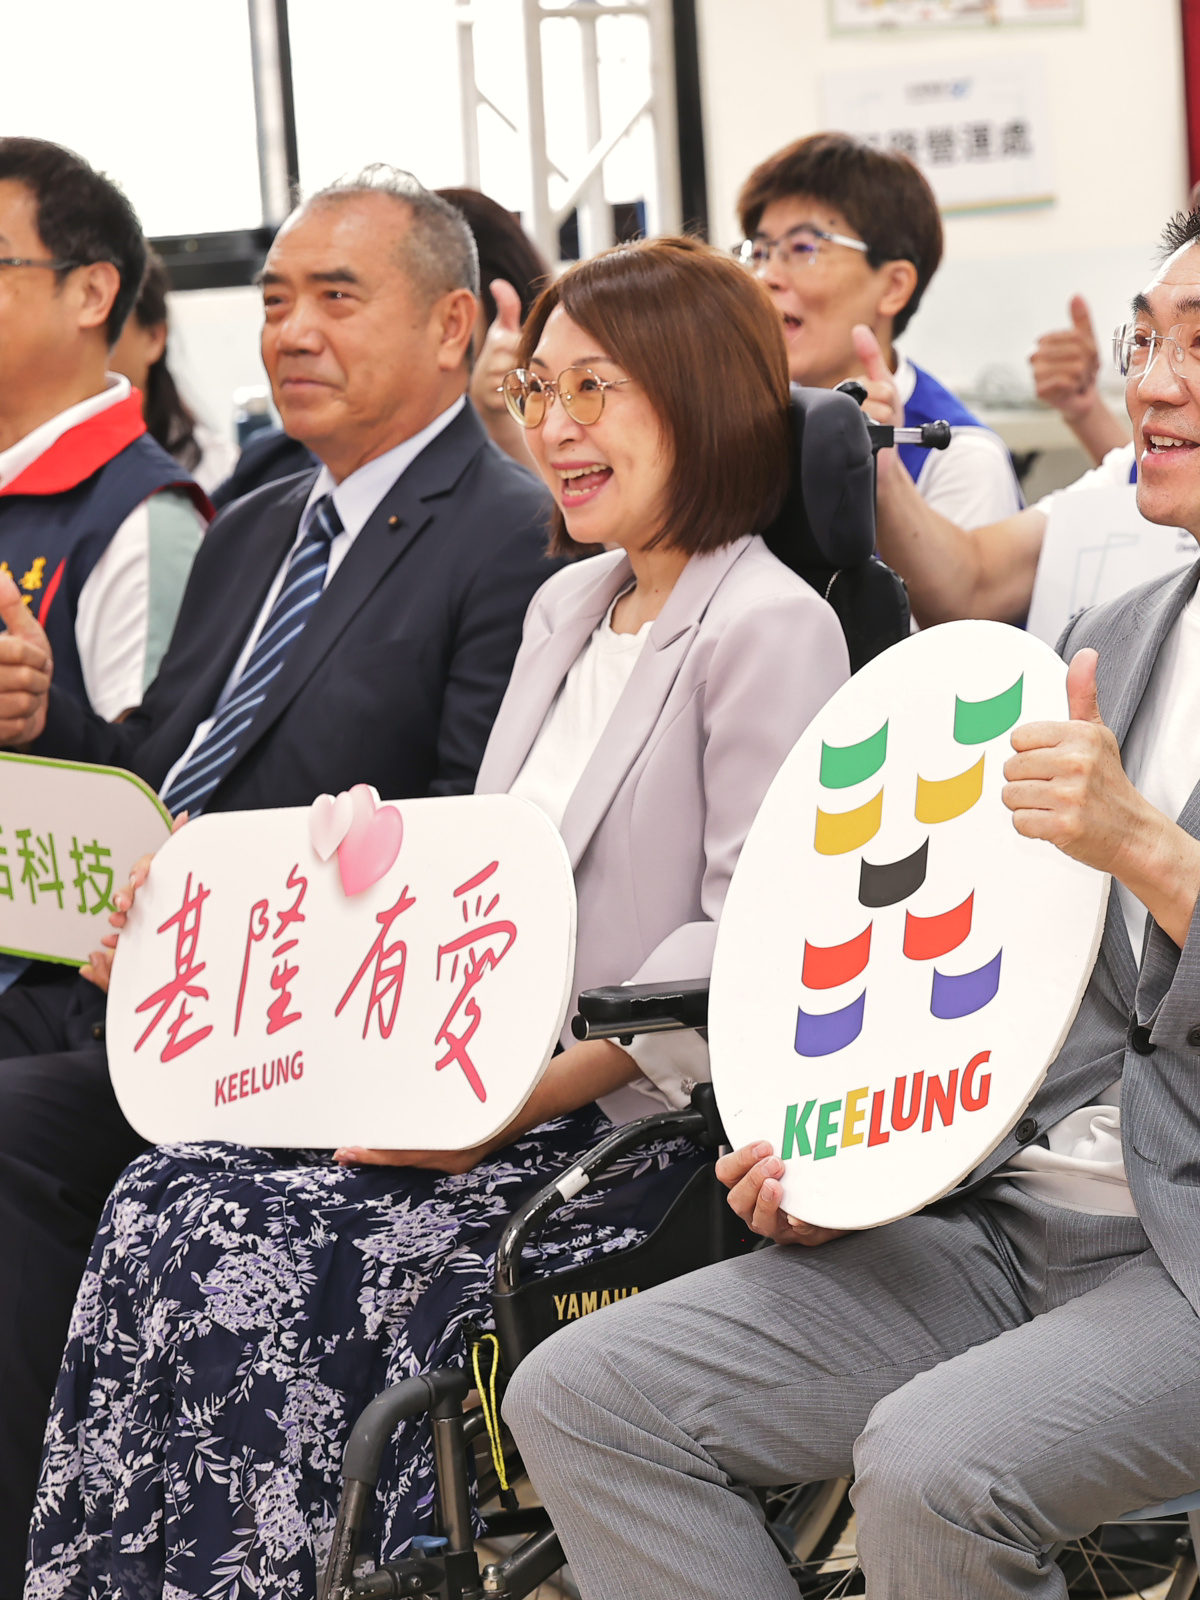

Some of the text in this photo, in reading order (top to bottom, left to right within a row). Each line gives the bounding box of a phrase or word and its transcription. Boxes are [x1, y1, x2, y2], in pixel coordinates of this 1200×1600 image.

[133, 859, 518, 1104] 基隆有愛
[215, 1051, 304, 1106] KEELUNG
[781, 1050, 992, 1161] KEELUNG
